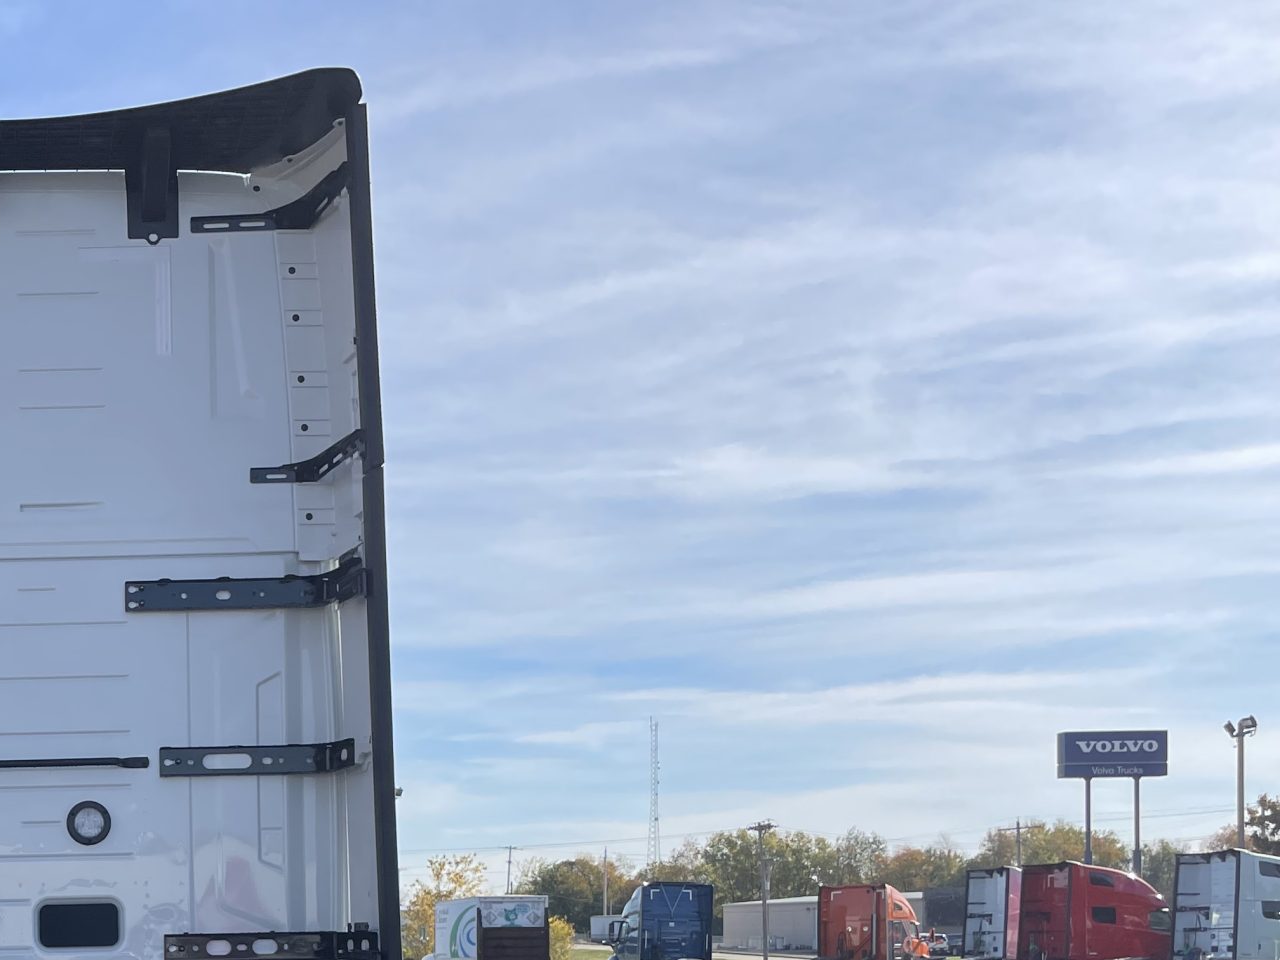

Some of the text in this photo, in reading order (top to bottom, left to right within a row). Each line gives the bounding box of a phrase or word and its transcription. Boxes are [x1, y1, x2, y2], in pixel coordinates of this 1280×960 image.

[1076, 739, 1159, 753] VOLVO
[1091, 766, 1144, 775] Volvo Trucks
